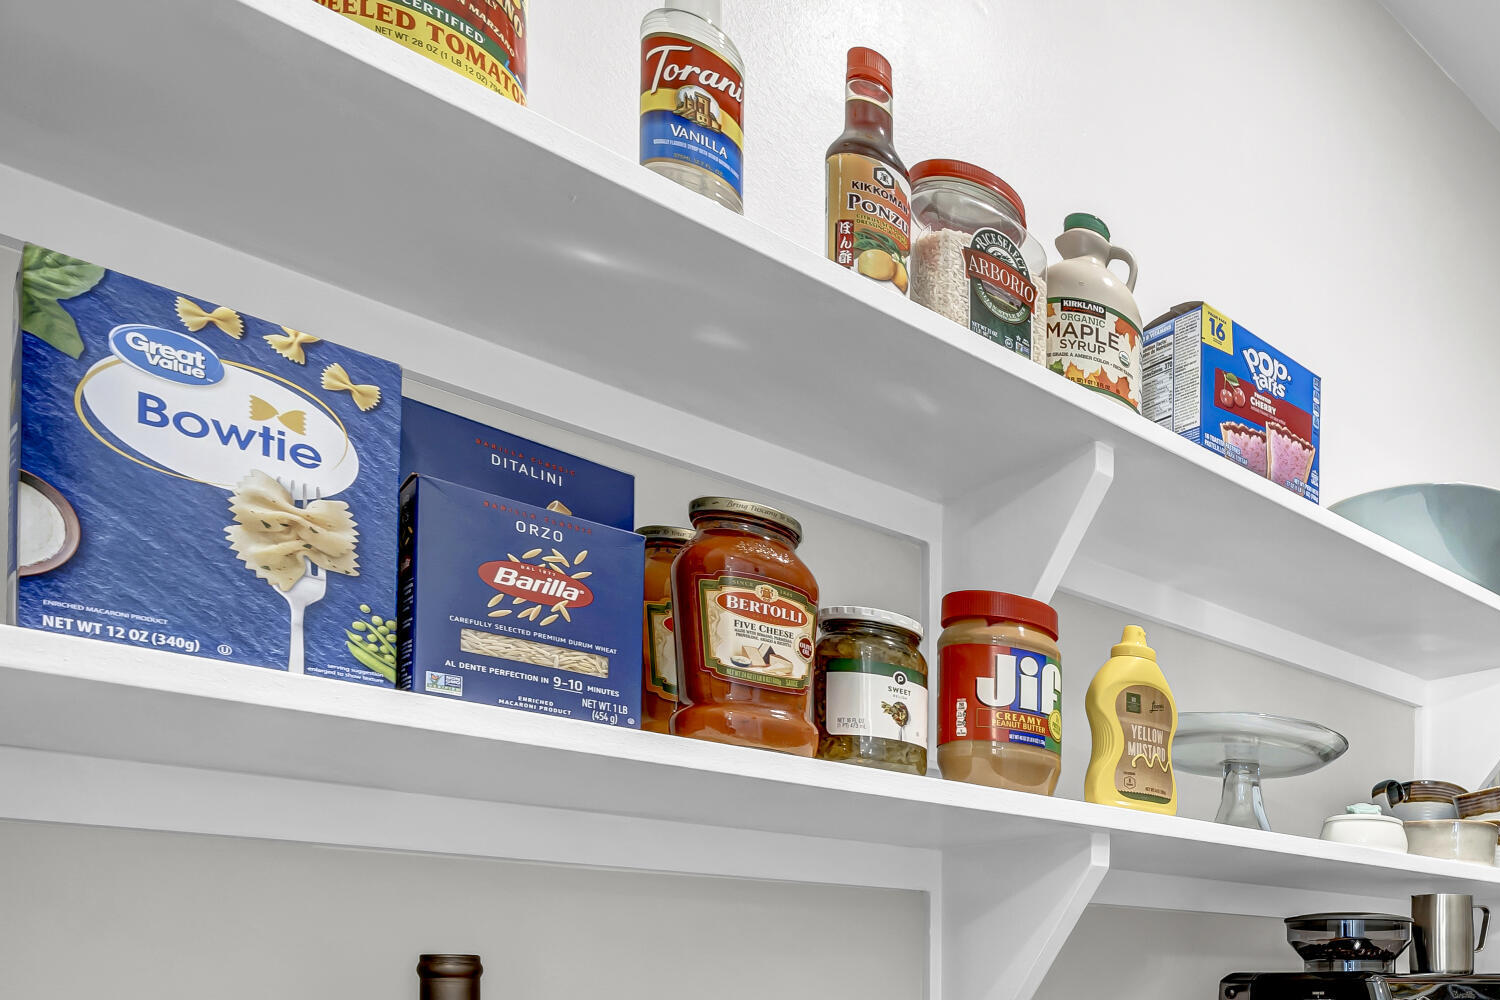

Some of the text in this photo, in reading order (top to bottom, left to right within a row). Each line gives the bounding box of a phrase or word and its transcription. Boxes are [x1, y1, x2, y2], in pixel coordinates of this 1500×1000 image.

[469, 4, 515, 57] MARZANO
[375, 25, 488, 86] NET WT 28 OZ (1 LB 12 OZ)
[646, 45, 743, 103] Torani
[671, 123, 728, 159] VANILLA
[851, 180, 909, 216] KIKKOMAN
[847, 192, 909, 238] PONZU
[838, 220, 853, 265] ぽん酢
[968, 254, 1034, 303] ARBORIO
[1063, 299, 1105, 314] KIRKLAND
[1060, 313, 1106, 328] ORGANIC
[1208, 317, 1226, 341] 16
[1047, 321, 1119, 351] MAPLE
[1060, 339, 1106, 355] SYRUP
[125, 331, 206, 370] Great
[1250, 396, 1277, 416] CHERRY
[137, 391, 322, 469] Bowtie
[475, 438, 524, 459] BARILLA
[491, 453, 562, 487] DITALINI
[515, 520, 563, 542] ORZO
[493, 566, 580, 602] Barilla
[42, 599, 168, 625] ENRICHED MACARONI PRODUCT
[726, 595, 803, 624] BERTOLLI
[42, 615, 200, 653] NET WT 12 OZ (340g)
[449, 615, 618, 655] CAREFULLY SELECTED PREMIUM DURUM WHEAT
[734, 619, 795, 639] FIVE CHEESE
[345, 672, 361, 680] show
[444, 659, 456, 668] AL
[459, 662, 487, 673] DENTE
[489, 667, 539, 683] PERFECTION
[540, 676, 549, 684] IN
[587, 685, 620, 698] MINUTES
[975, 653, 1061, 715] Jif
[517, 695, 554, 707] ENRICHED
[887, 685, 911, 696] SWEET
[498, 698, 572, 716] MACARONI PRODUCT
[581, 698, 598, 709] NET
[618, 705, 628, 715] LB
[591, 709, 618, 725] (454 g)
[996, 711, 1042, 725] CREAMY
[992, 718, 1046, 734] PEANUT BUTTER
[1131, 724, 1164, 745] YELLOW
[1127, 741, 1166, 763] MUSTARD
